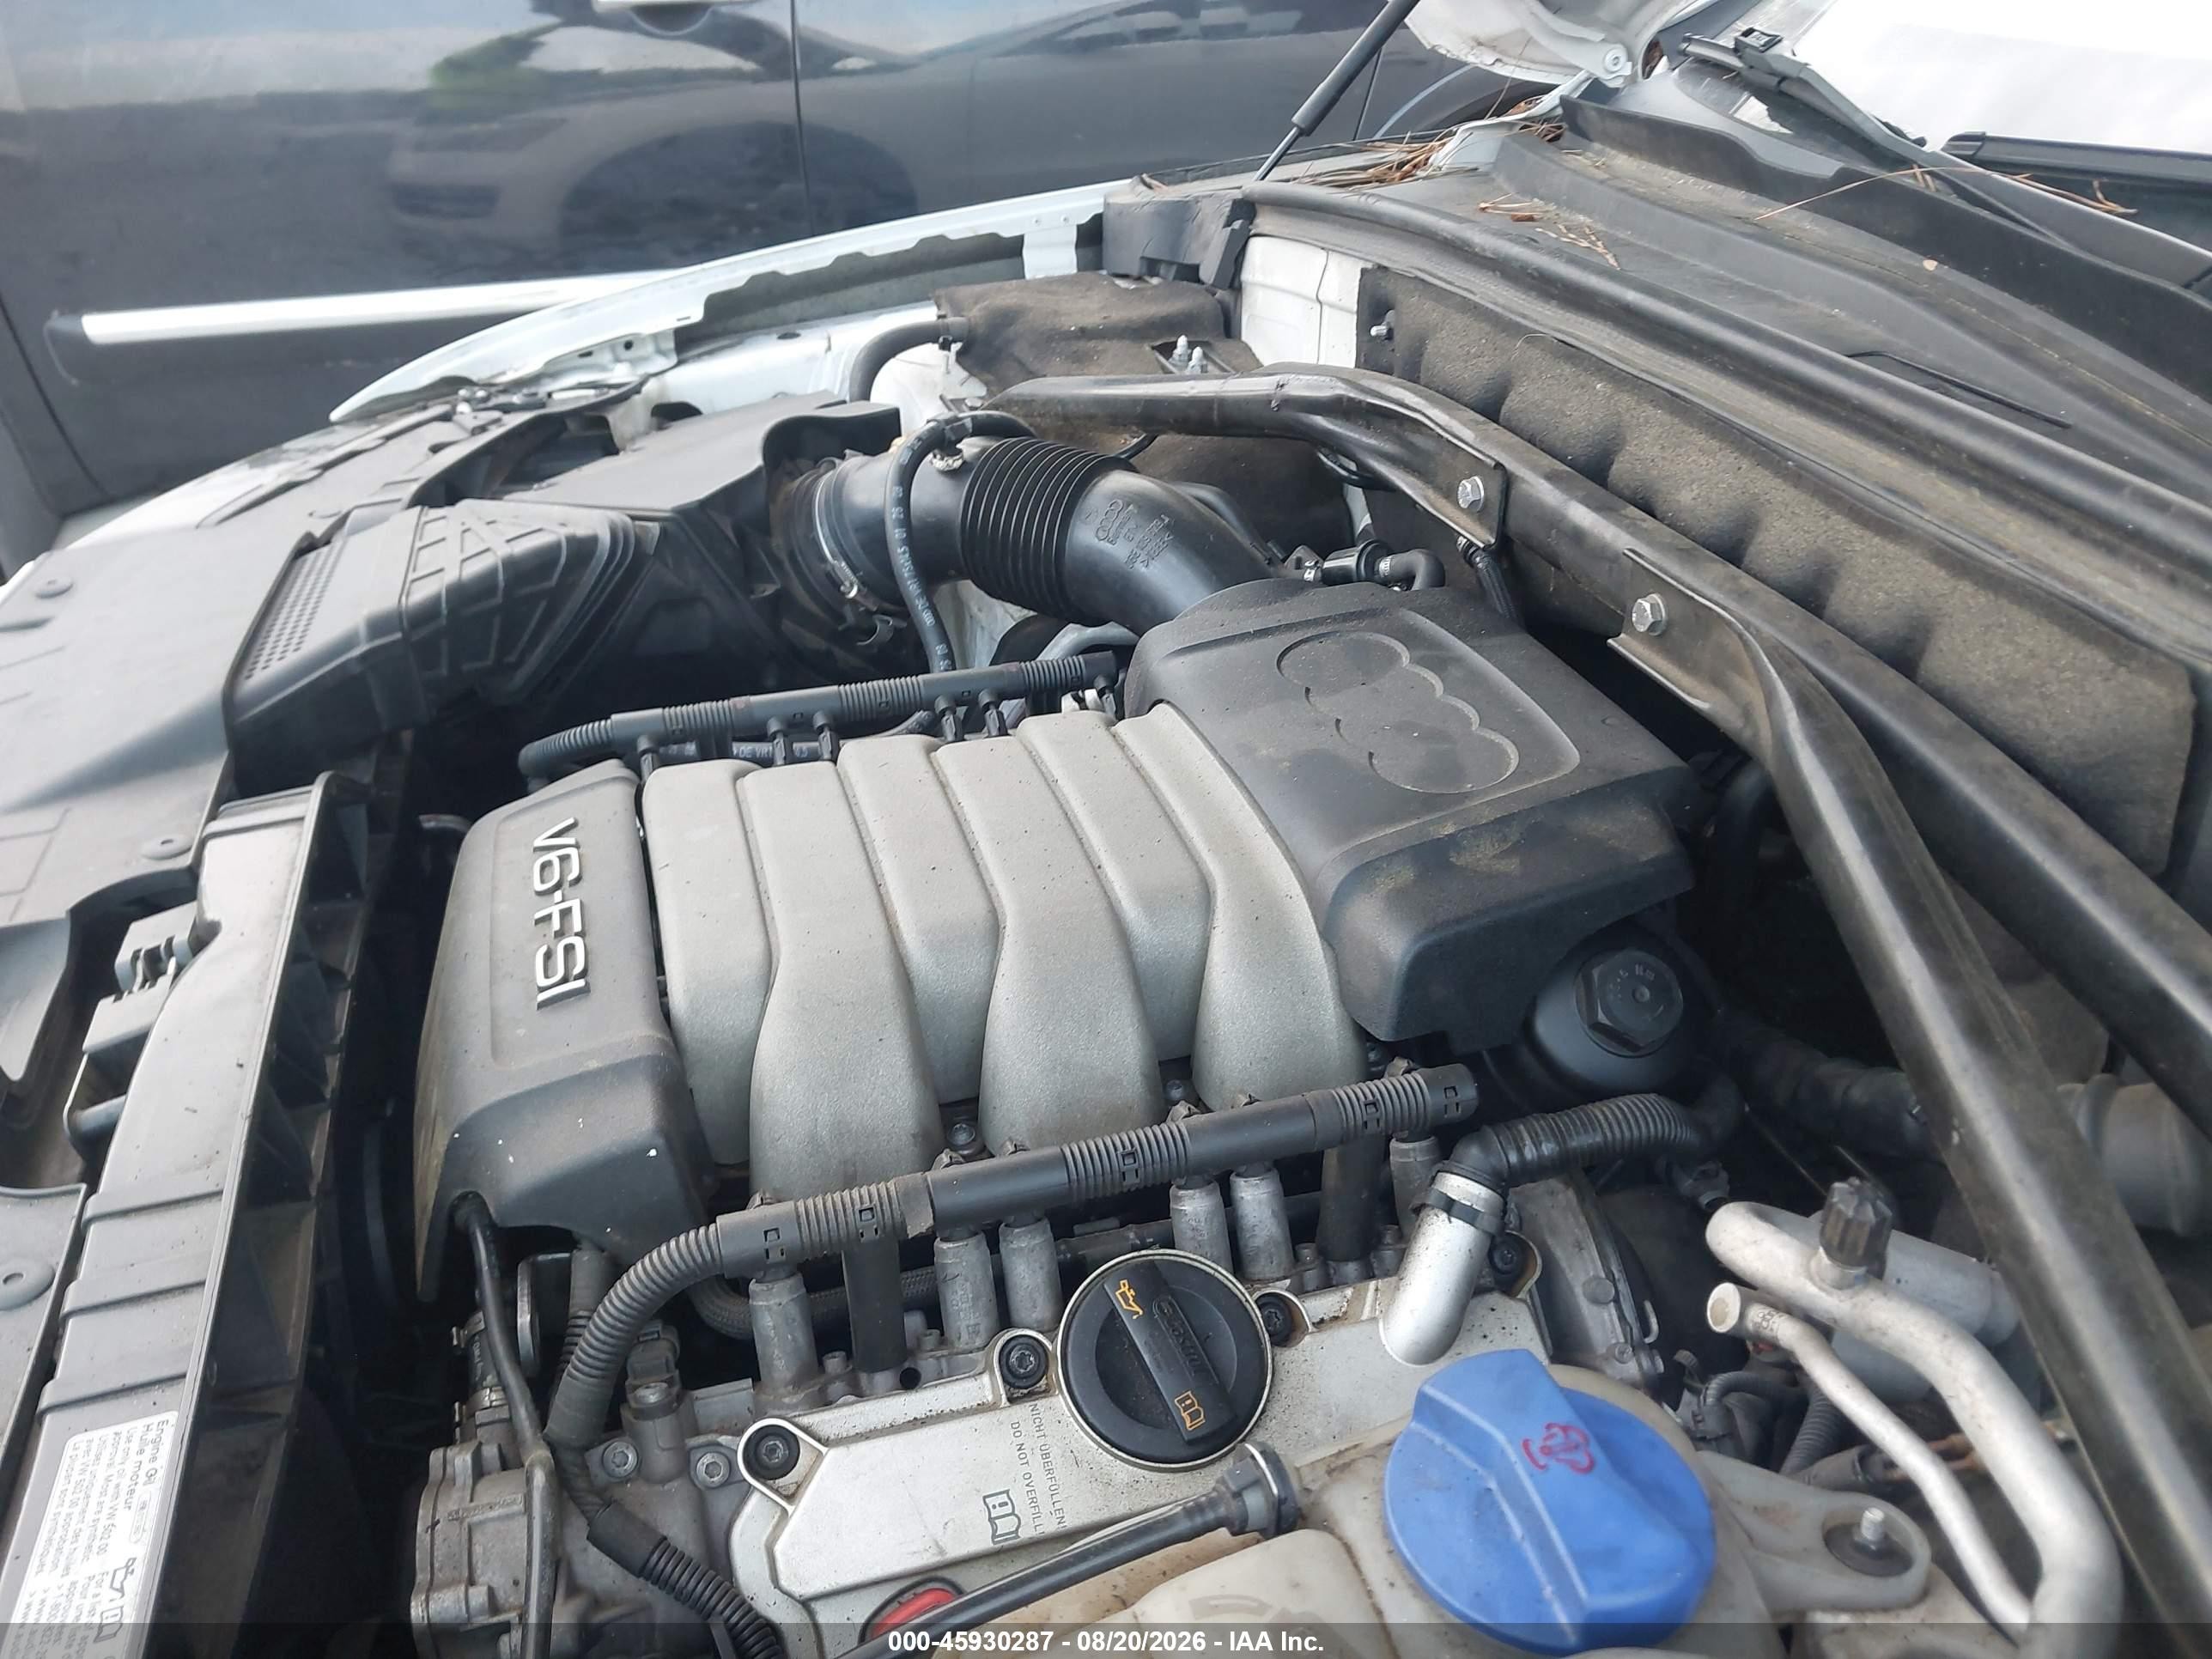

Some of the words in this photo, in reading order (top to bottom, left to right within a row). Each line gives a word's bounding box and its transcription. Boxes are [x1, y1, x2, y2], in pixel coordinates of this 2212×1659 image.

[532, 817, 590, 1008] V6-FSI
[135, 1421, 155, 1456] Huile
[144, 1419, 169, 1465] Engine
[1010, 1421, 1023, 1438] DO
[1016, 1443, 1030, 1467] NOT
[1030, 1403, 1047, 1439] NICHT
[1039, 1443, 1068, 1529] ÜBERFÜLLEN!
[121, 1458, 144, 1512] moteur
[1022, 1472, 1045, 1535] OVERFILL!
